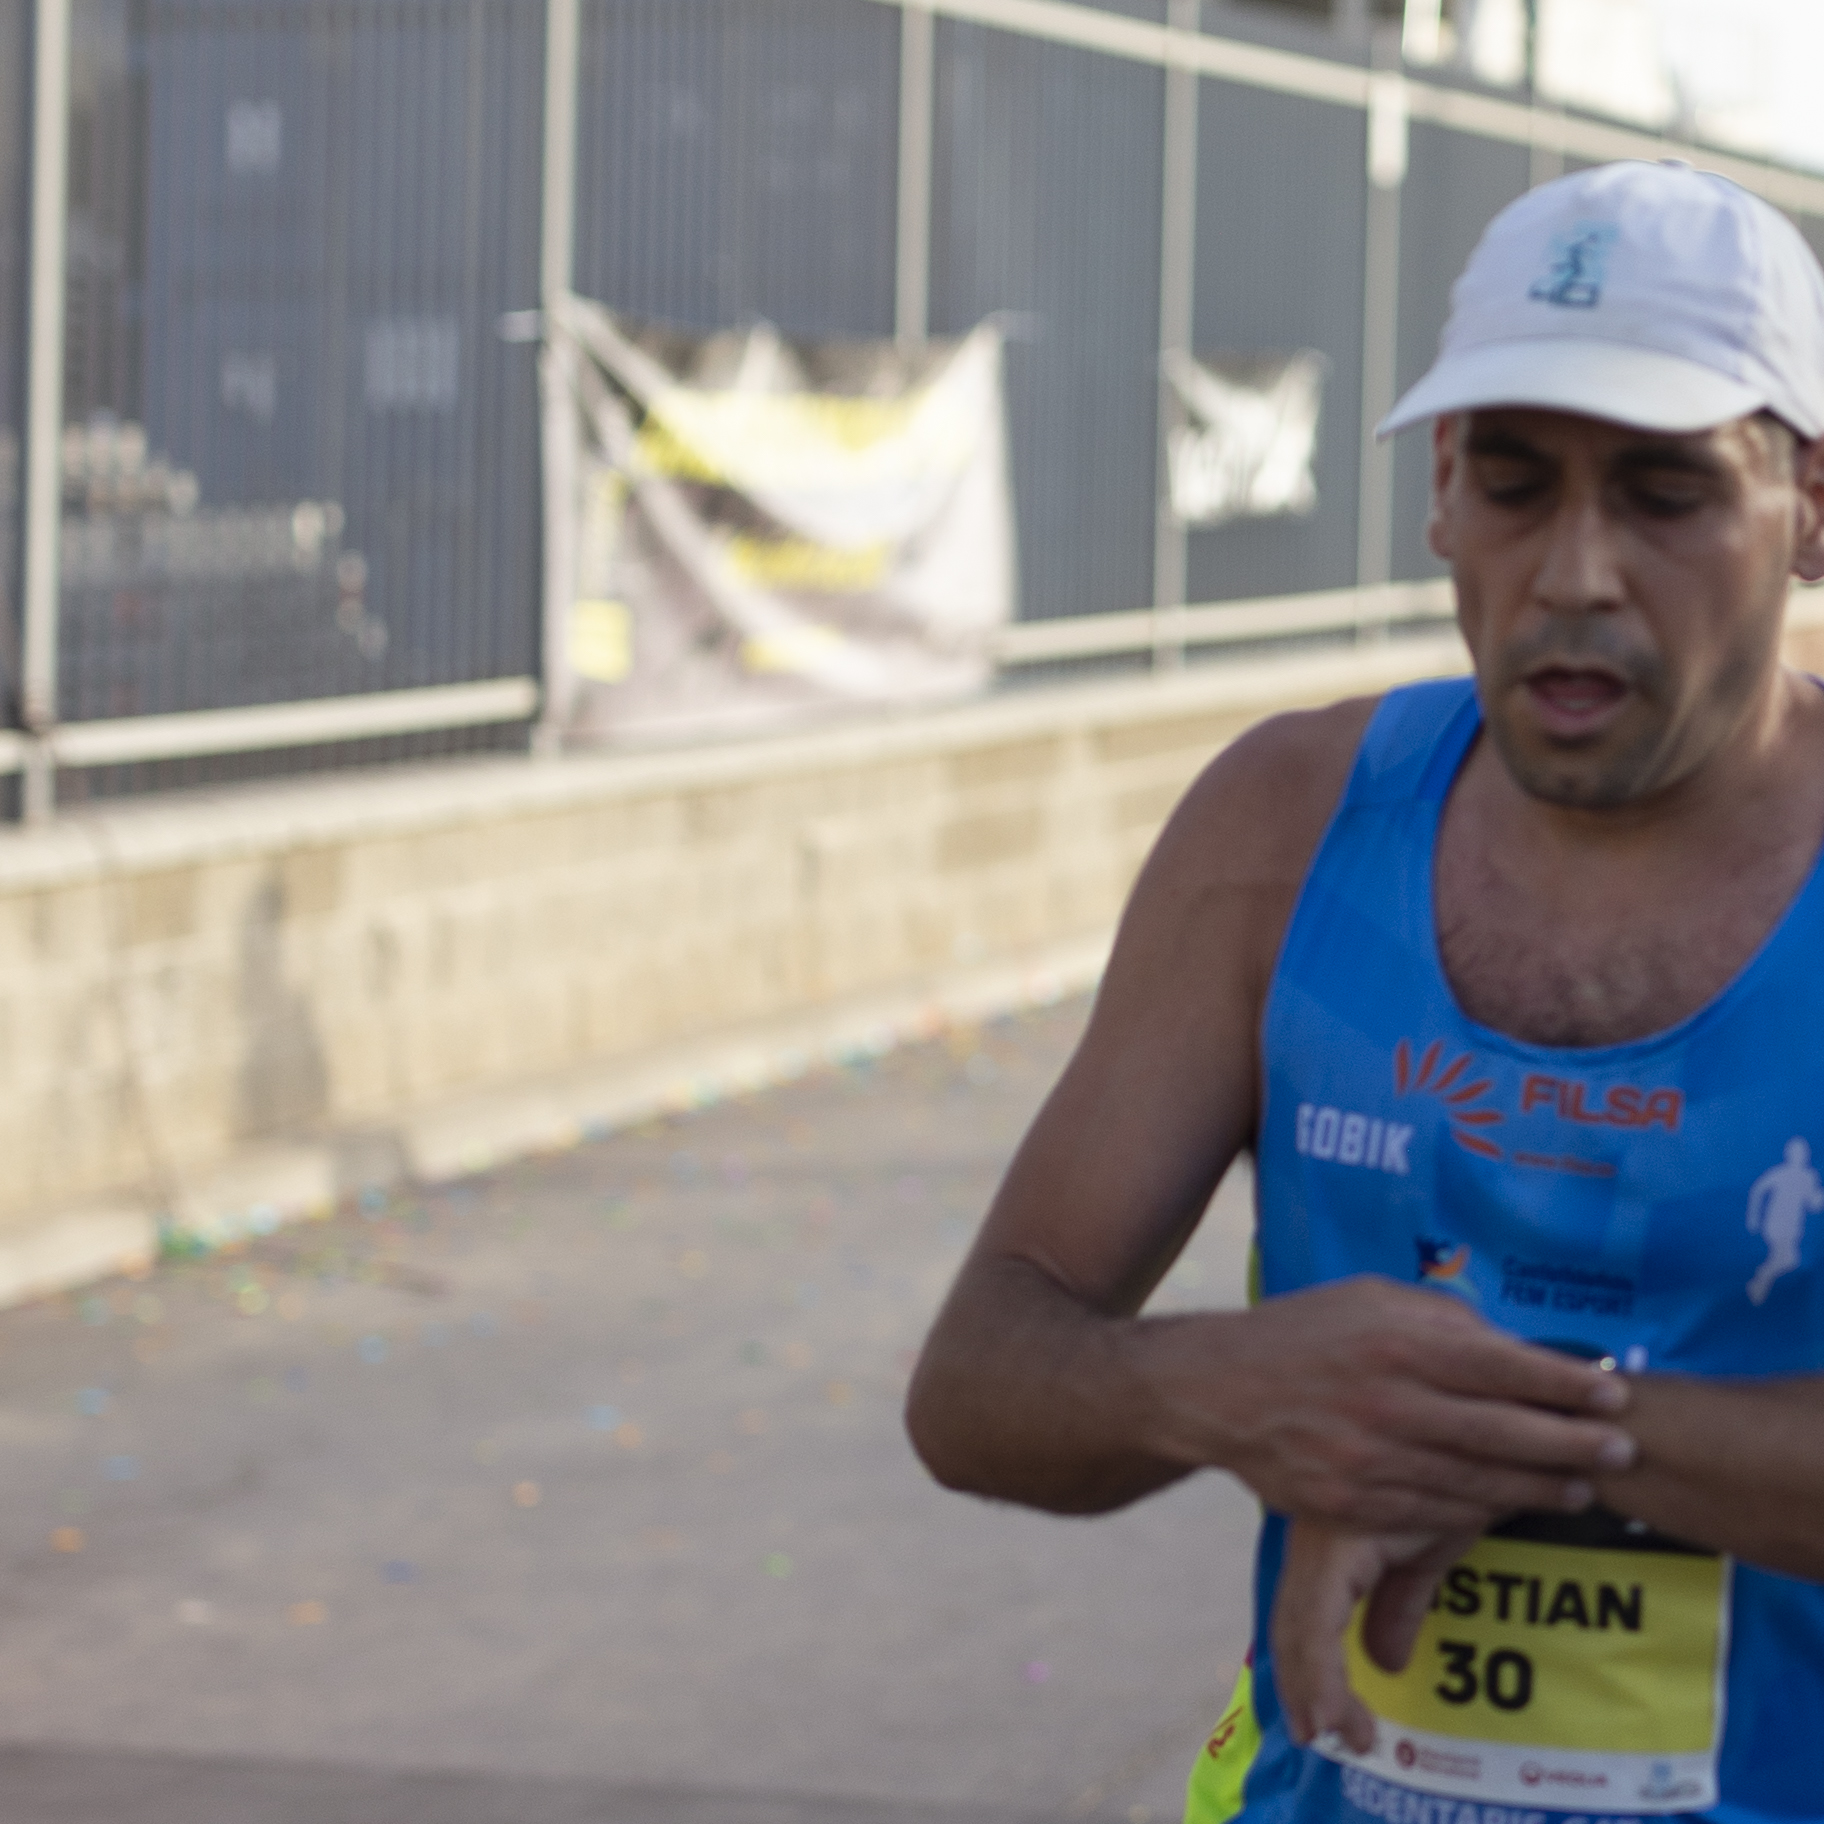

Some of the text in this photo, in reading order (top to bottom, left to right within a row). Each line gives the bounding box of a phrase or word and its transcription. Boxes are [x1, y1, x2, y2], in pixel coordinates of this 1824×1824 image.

[1521, 1071, 1686, 1134] FILSA
[1430, 1566, 1644, 1633] STIAN
[1436, 1637, 1535, 1713] 30
